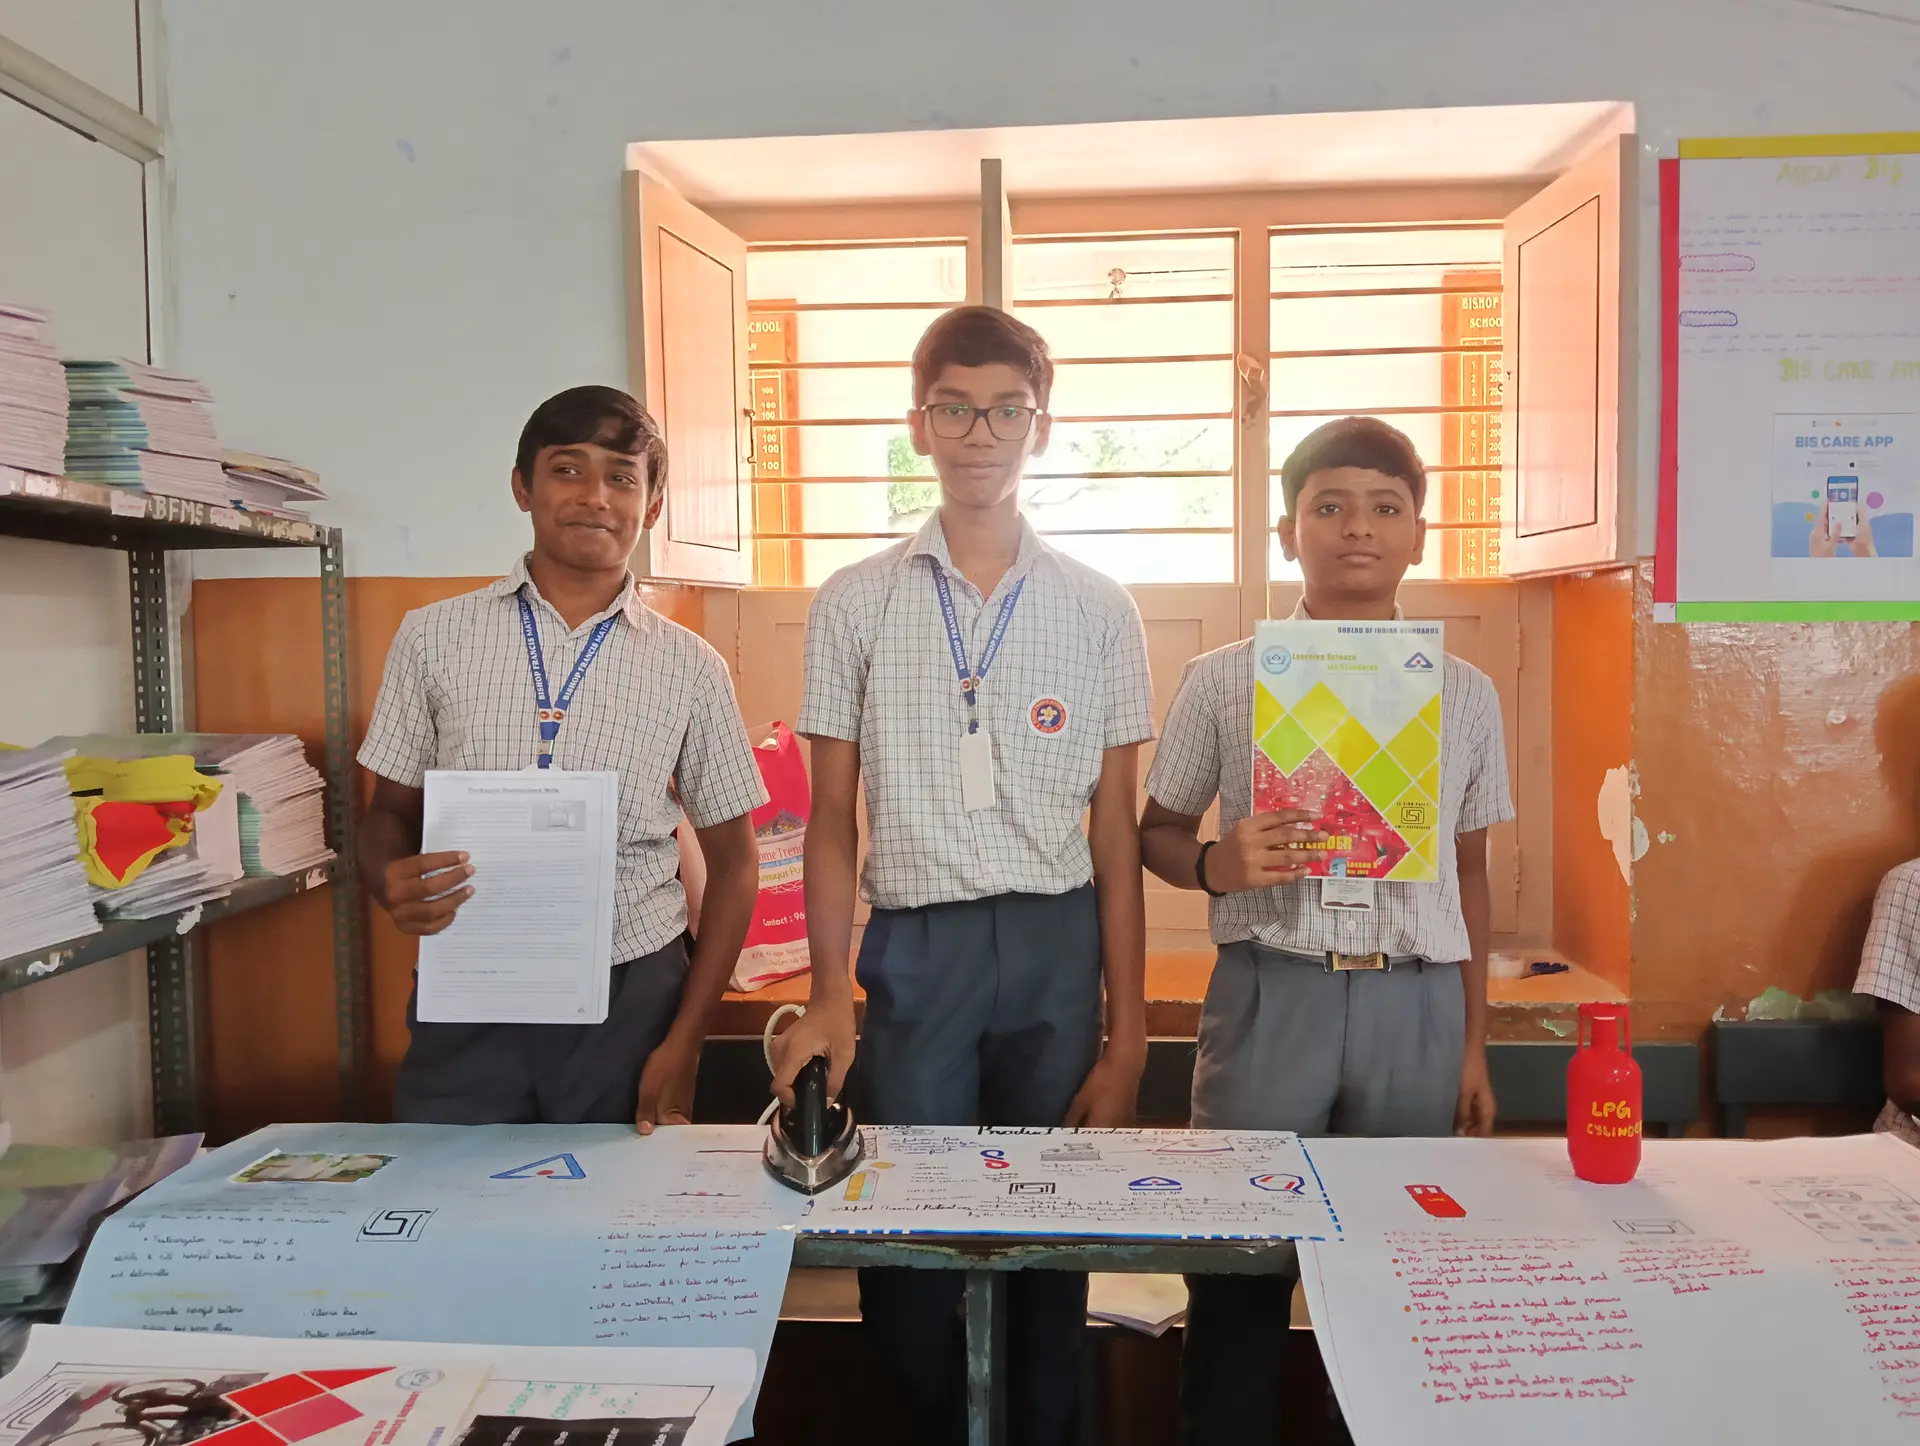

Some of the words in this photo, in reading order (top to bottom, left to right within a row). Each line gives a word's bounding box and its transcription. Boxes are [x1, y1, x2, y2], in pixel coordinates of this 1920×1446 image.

[1462, 297, 1500, 310] BISHOP
[748, 321, 781, 333] CHOOL
[1469, 317, 1503, 328] SCHOO
[761, 387, 774, 395] 100
[761, 411, 776, 419] 100
[762, 433, 777, 442] 100
[1795, 436, 1818, 448] BIS
[1821, 436, 1860, 448] CARE
[1864, 436, 1894, 448] APP
[762, 445, 779, 454] 100
[762, 461, 779, 470] 100
[945, 606, 960, 640] FRANCIS
[1400, 627, 1440, 635] STANDARDS
[981, 640, 997, 671] BISHOP
[993, 607, 1010, 641] FRANCIS
[526, 637, 541, 671] FRANCIS
[953, 640, 966, 670] BISHOP
[1292, 653, 1325, 661] Learning
[1327, 653, 1357, 661] Science
[562, 671, 582, 701] BISHOP
[577, 642, 600, 673] FRANCIS
[533, 670, 546, 700] BISHOP
[759, 851, 777, 862] ome
[762, 916, 788, 927] Contact
[1591, 1100, 1631, 1119] LPG
[978, 1125, 1053, 1136] Product
